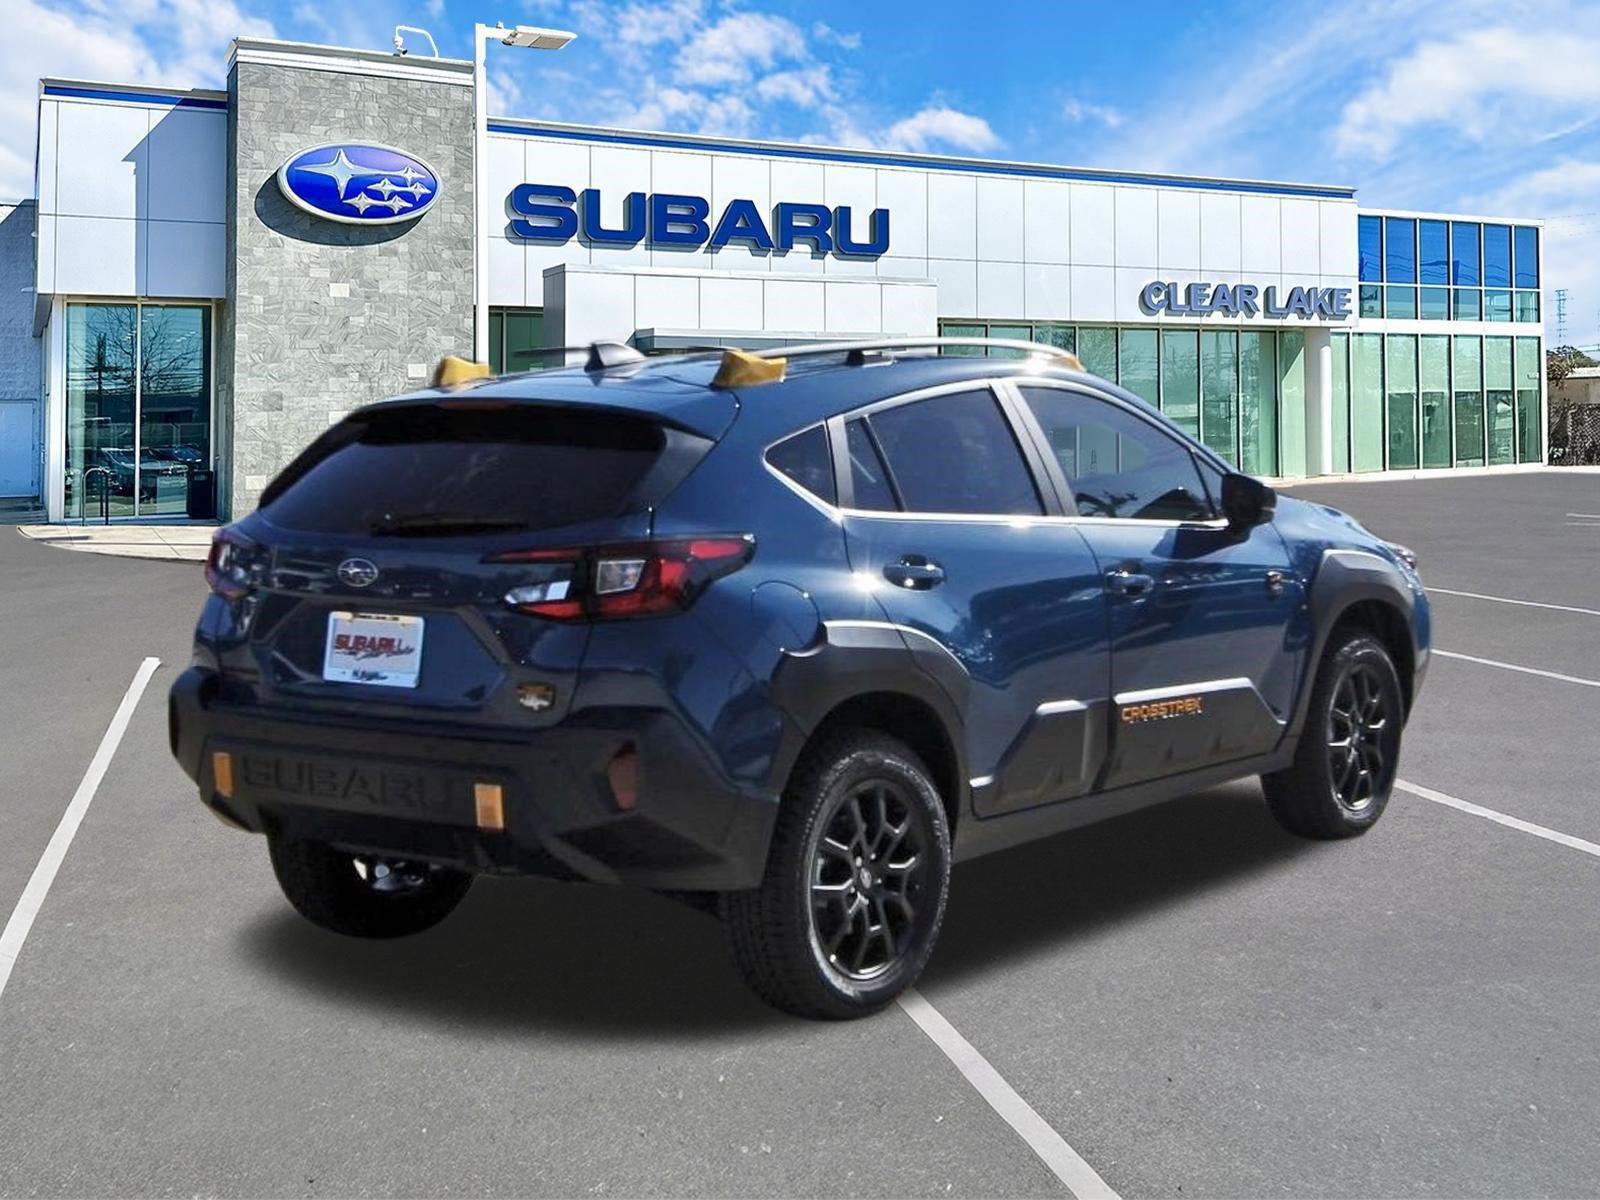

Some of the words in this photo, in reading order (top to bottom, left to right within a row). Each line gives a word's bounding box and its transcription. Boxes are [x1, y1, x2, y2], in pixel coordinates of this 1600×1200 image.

[506, 183, 889, 260] SUBARU
[1140, 281, 1259, 318] CLEAR
[1264, 286, 1352, 320] LAKE
[242, 755, 455, 808] SUBARU
